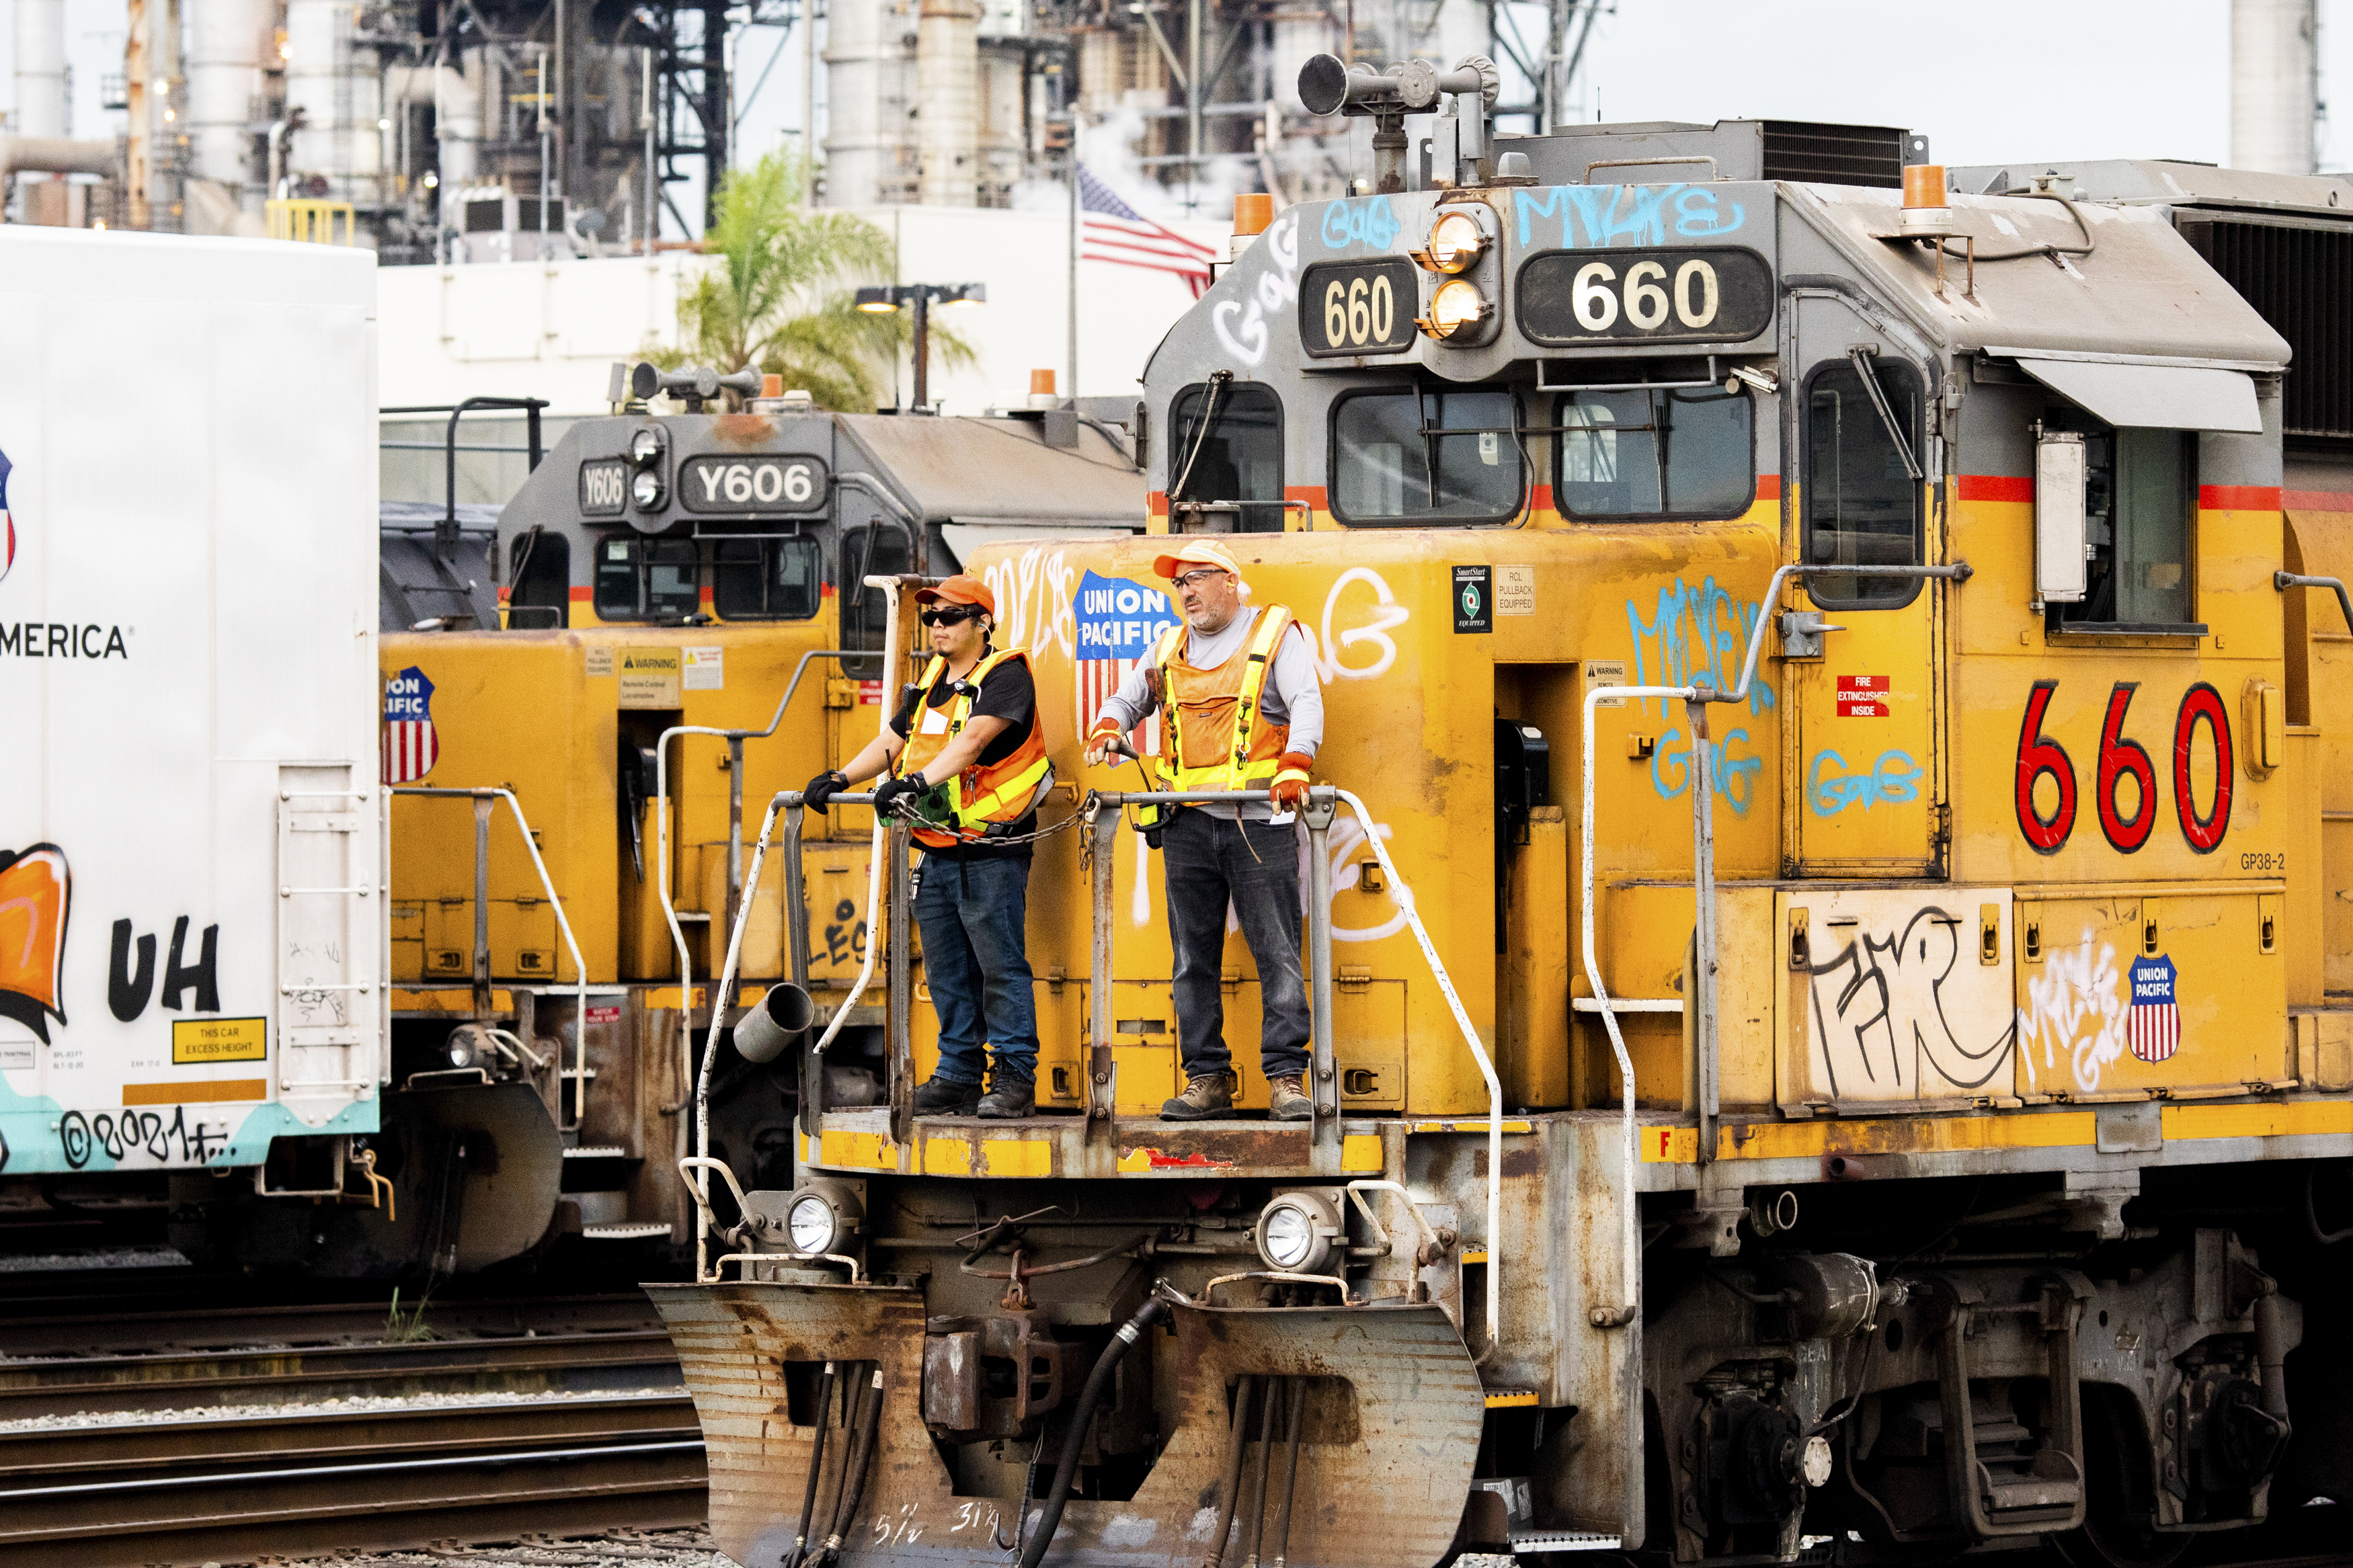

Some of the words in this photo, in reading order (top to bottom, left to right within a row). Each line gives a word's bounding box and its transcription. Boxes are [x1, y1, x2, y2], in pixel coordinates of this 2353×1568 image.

[1572, 259, 1718, 331] 660
[1325, 275, 1394, 347] 660
[586, 468, 623, 504] Y606
[698, 464, 812, 502] Y606
[1457, 567, 1485, 576] SmartStart
[1509, 572, 1522, 581] RCL
[1499, 585, 1533, 595] PULLBACK
[1084, 589, 1164, 615] UNION
[1499, 599, 1532, 608] EQUIPPED
[1458, 620, 1485, 628] EQUIPPED
[635, 659, 676, 669] WARNING
[1856, 677, 1871, 686] FIRE
[1851, 706, 1874, 715] INSIDE
[2014, 679, 2234, 856] 660
[2241, 854, 2284, 871] GP38-2
[108, 915, 220, 1022] UH
[2137, 967, 2168, 981] UNION
[2136, 983, 2170, 997] PACIFIC
[200, 1028, 218, 1038] THIS
[221, 1028, 239, 1037] CAR
[186, 1044, 220, 1054] EXCESS
[222, 1042, 252, 1053] HEIGHT
